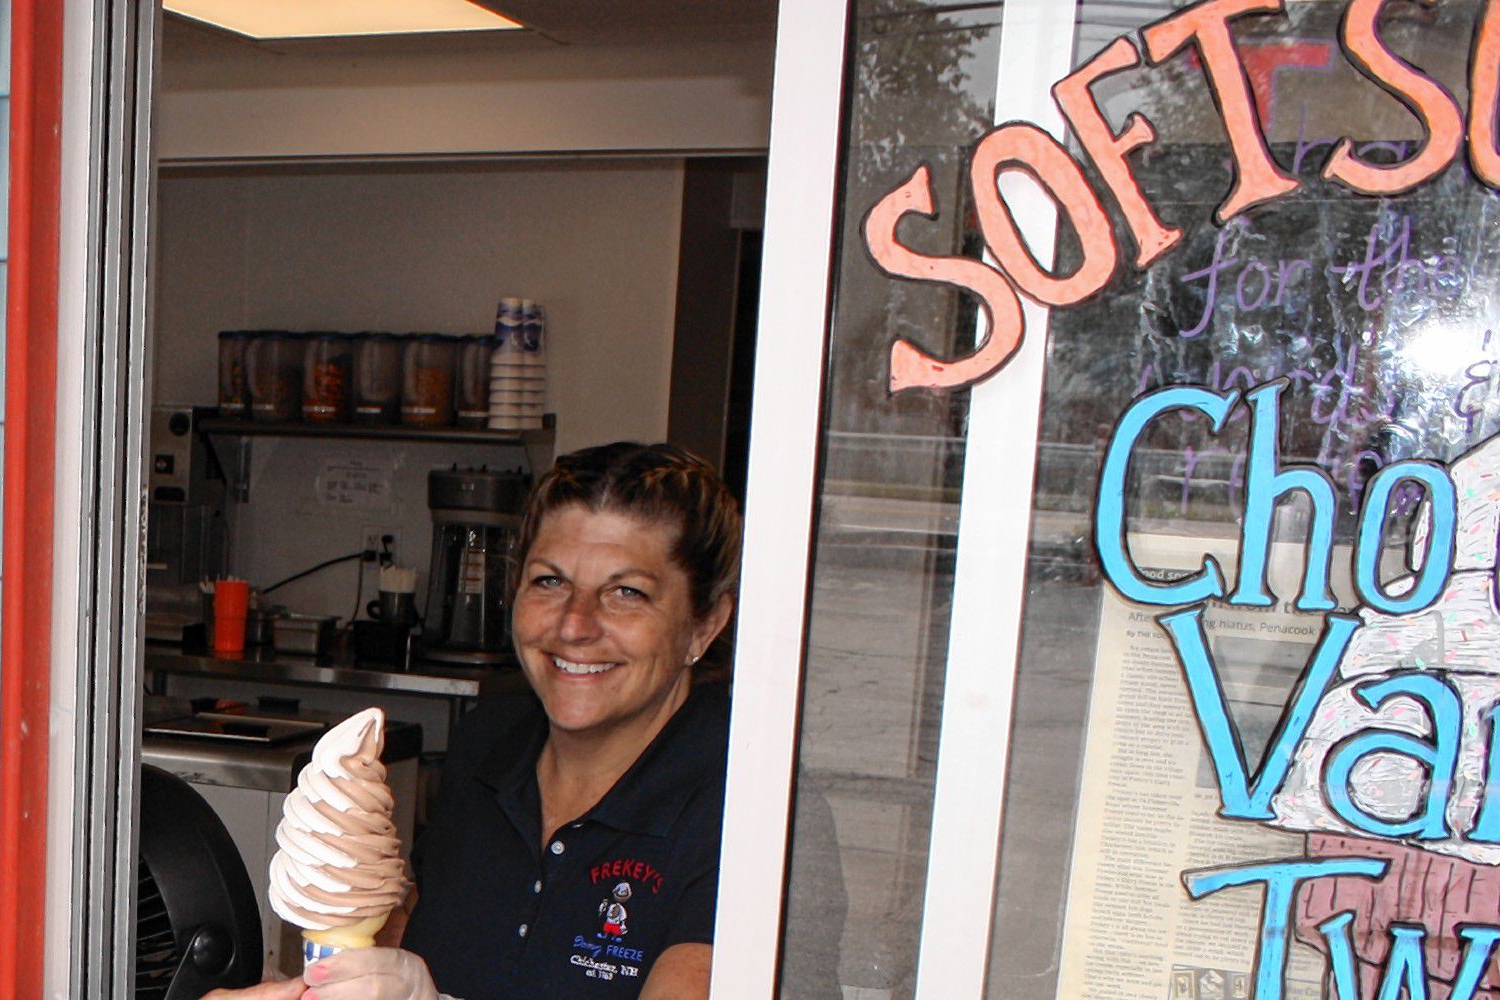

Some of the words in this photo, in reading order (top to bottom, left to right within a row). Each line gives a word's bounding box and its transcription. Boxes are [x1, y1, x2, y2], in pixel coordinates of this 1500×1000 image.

[589, 858, 664, 894] FREKEY'S
[606, 944, 645, 961] FREEZE
[620, 964, 640, 977] NH
